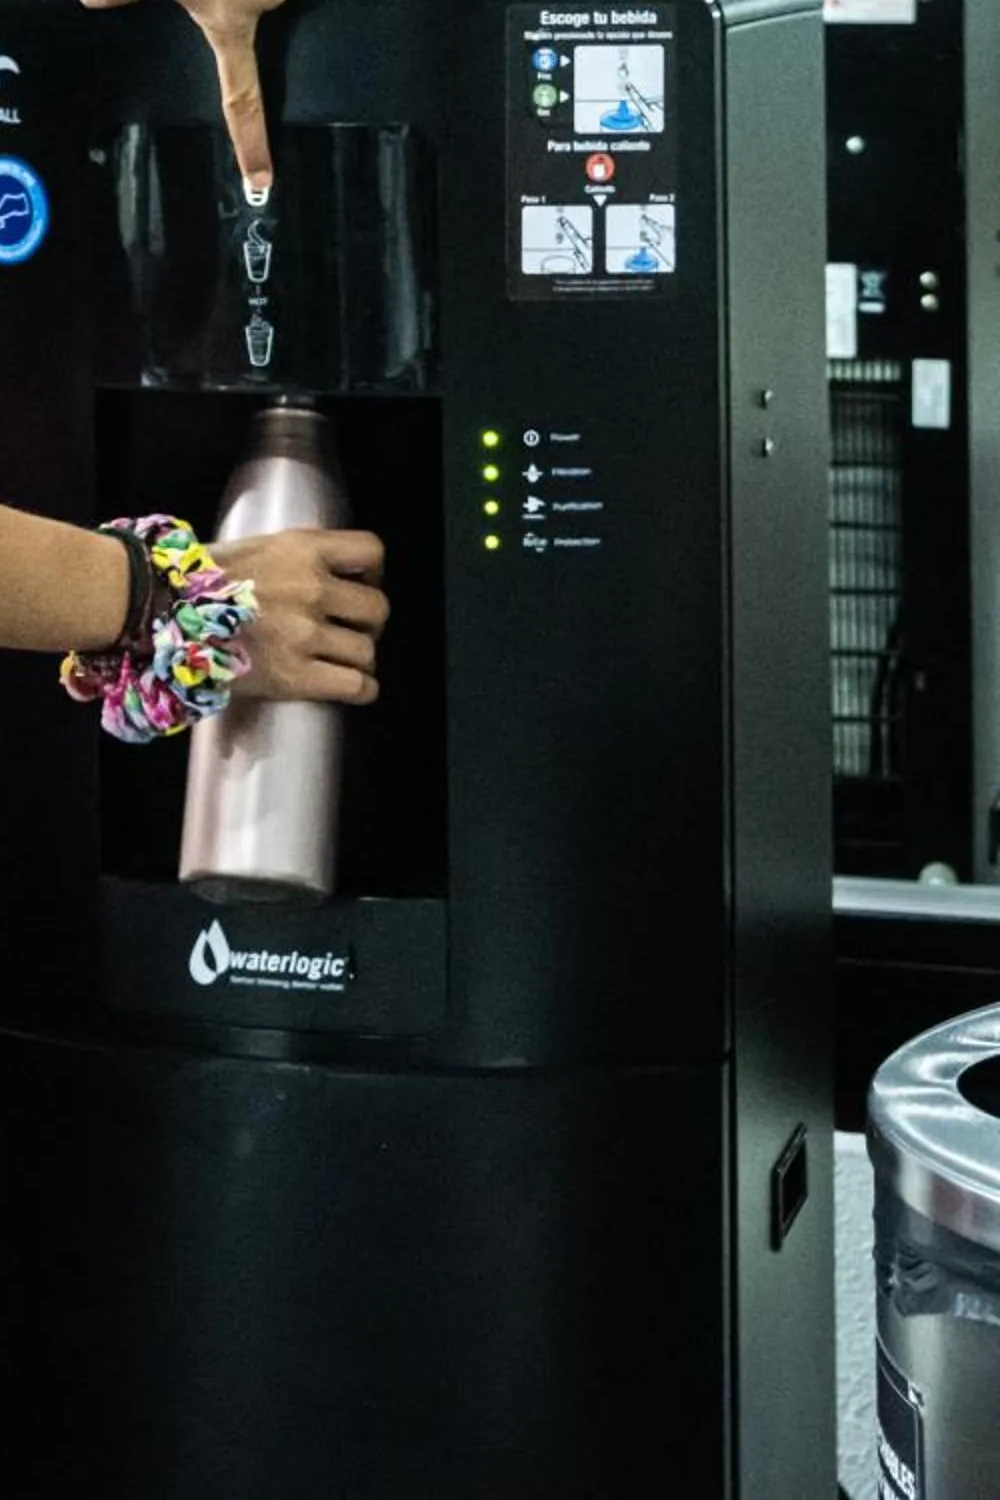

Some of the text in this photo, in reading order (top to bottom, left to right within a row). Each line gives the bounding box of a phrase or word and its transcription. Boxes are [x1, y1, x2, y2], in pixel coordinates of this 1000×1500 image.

[540, 10, 657, 28] Escoge tu bebida
[230, 950, 345, 980] waterlogic
